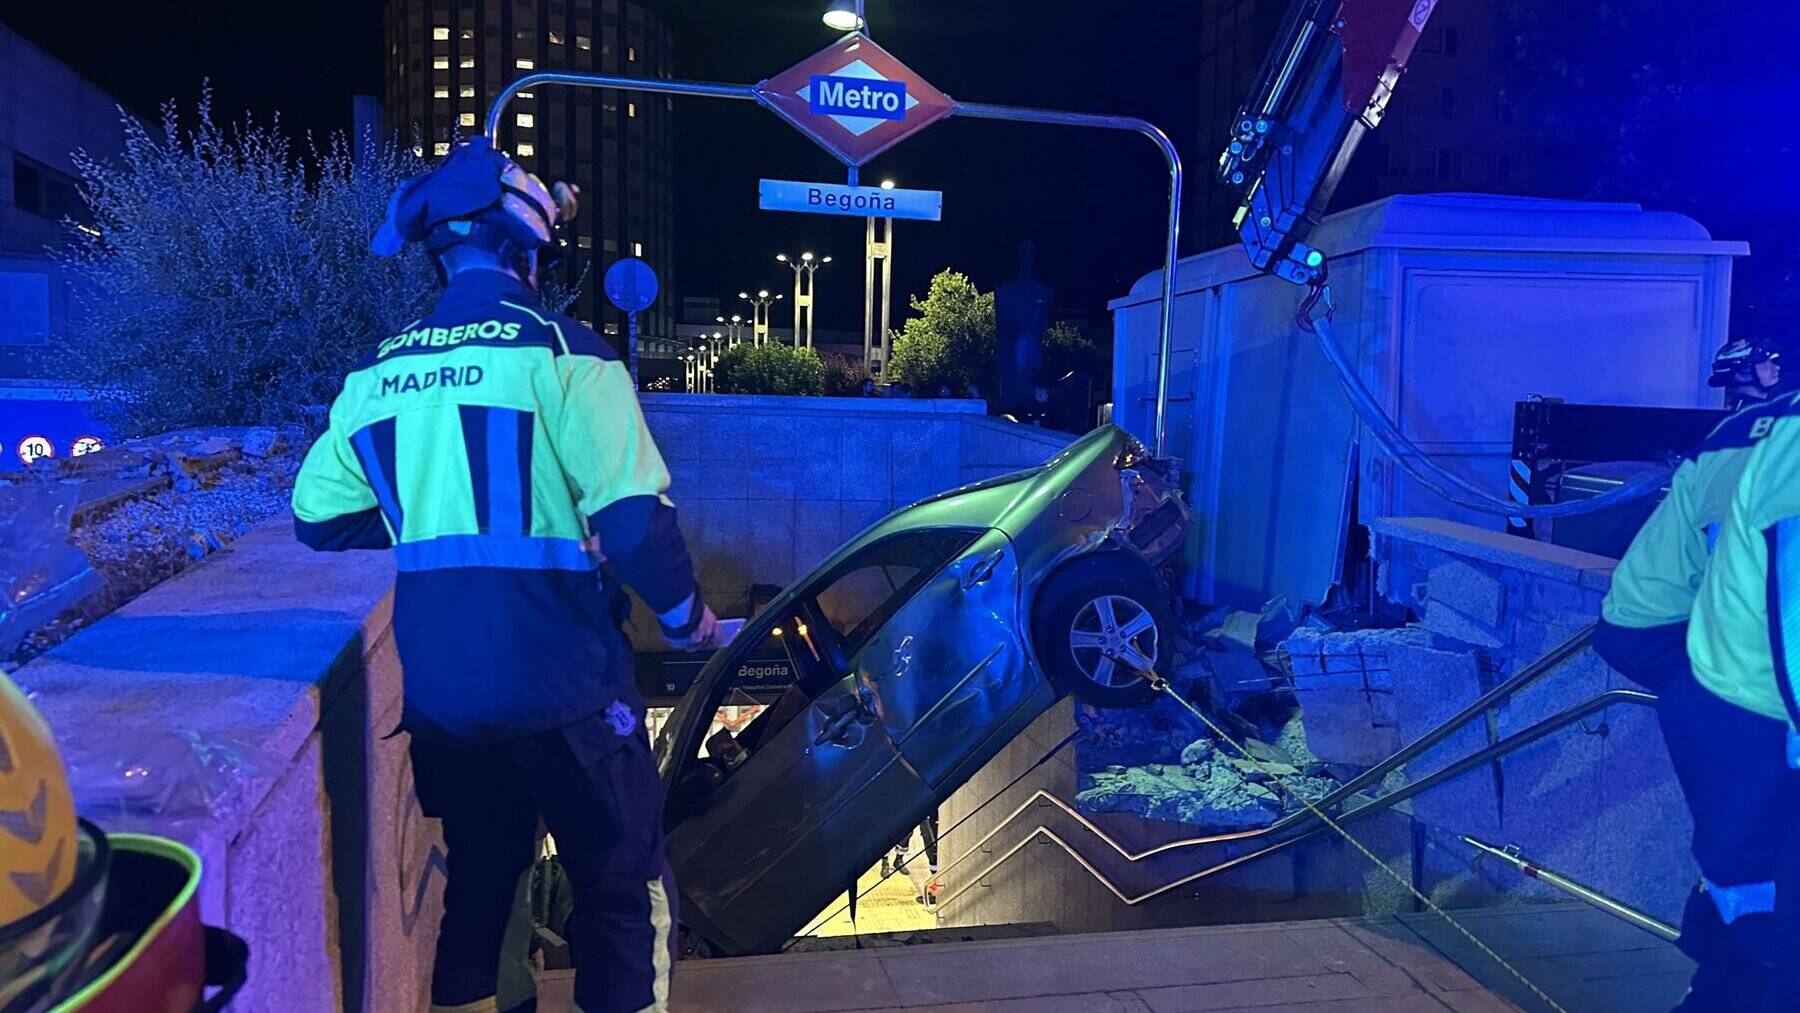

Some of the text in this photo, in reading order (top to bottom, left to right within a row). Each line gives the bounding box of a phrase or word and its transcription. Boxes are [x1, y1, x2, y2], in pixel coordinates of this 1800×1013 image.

[819, 81, 899, 112] Metro
[808, 188, 895, 211] Begoña
[381, 365, 484, 397] MADRID
[26, 443, 44, 456] 10
[737, 664, 789, 679] Begoña
